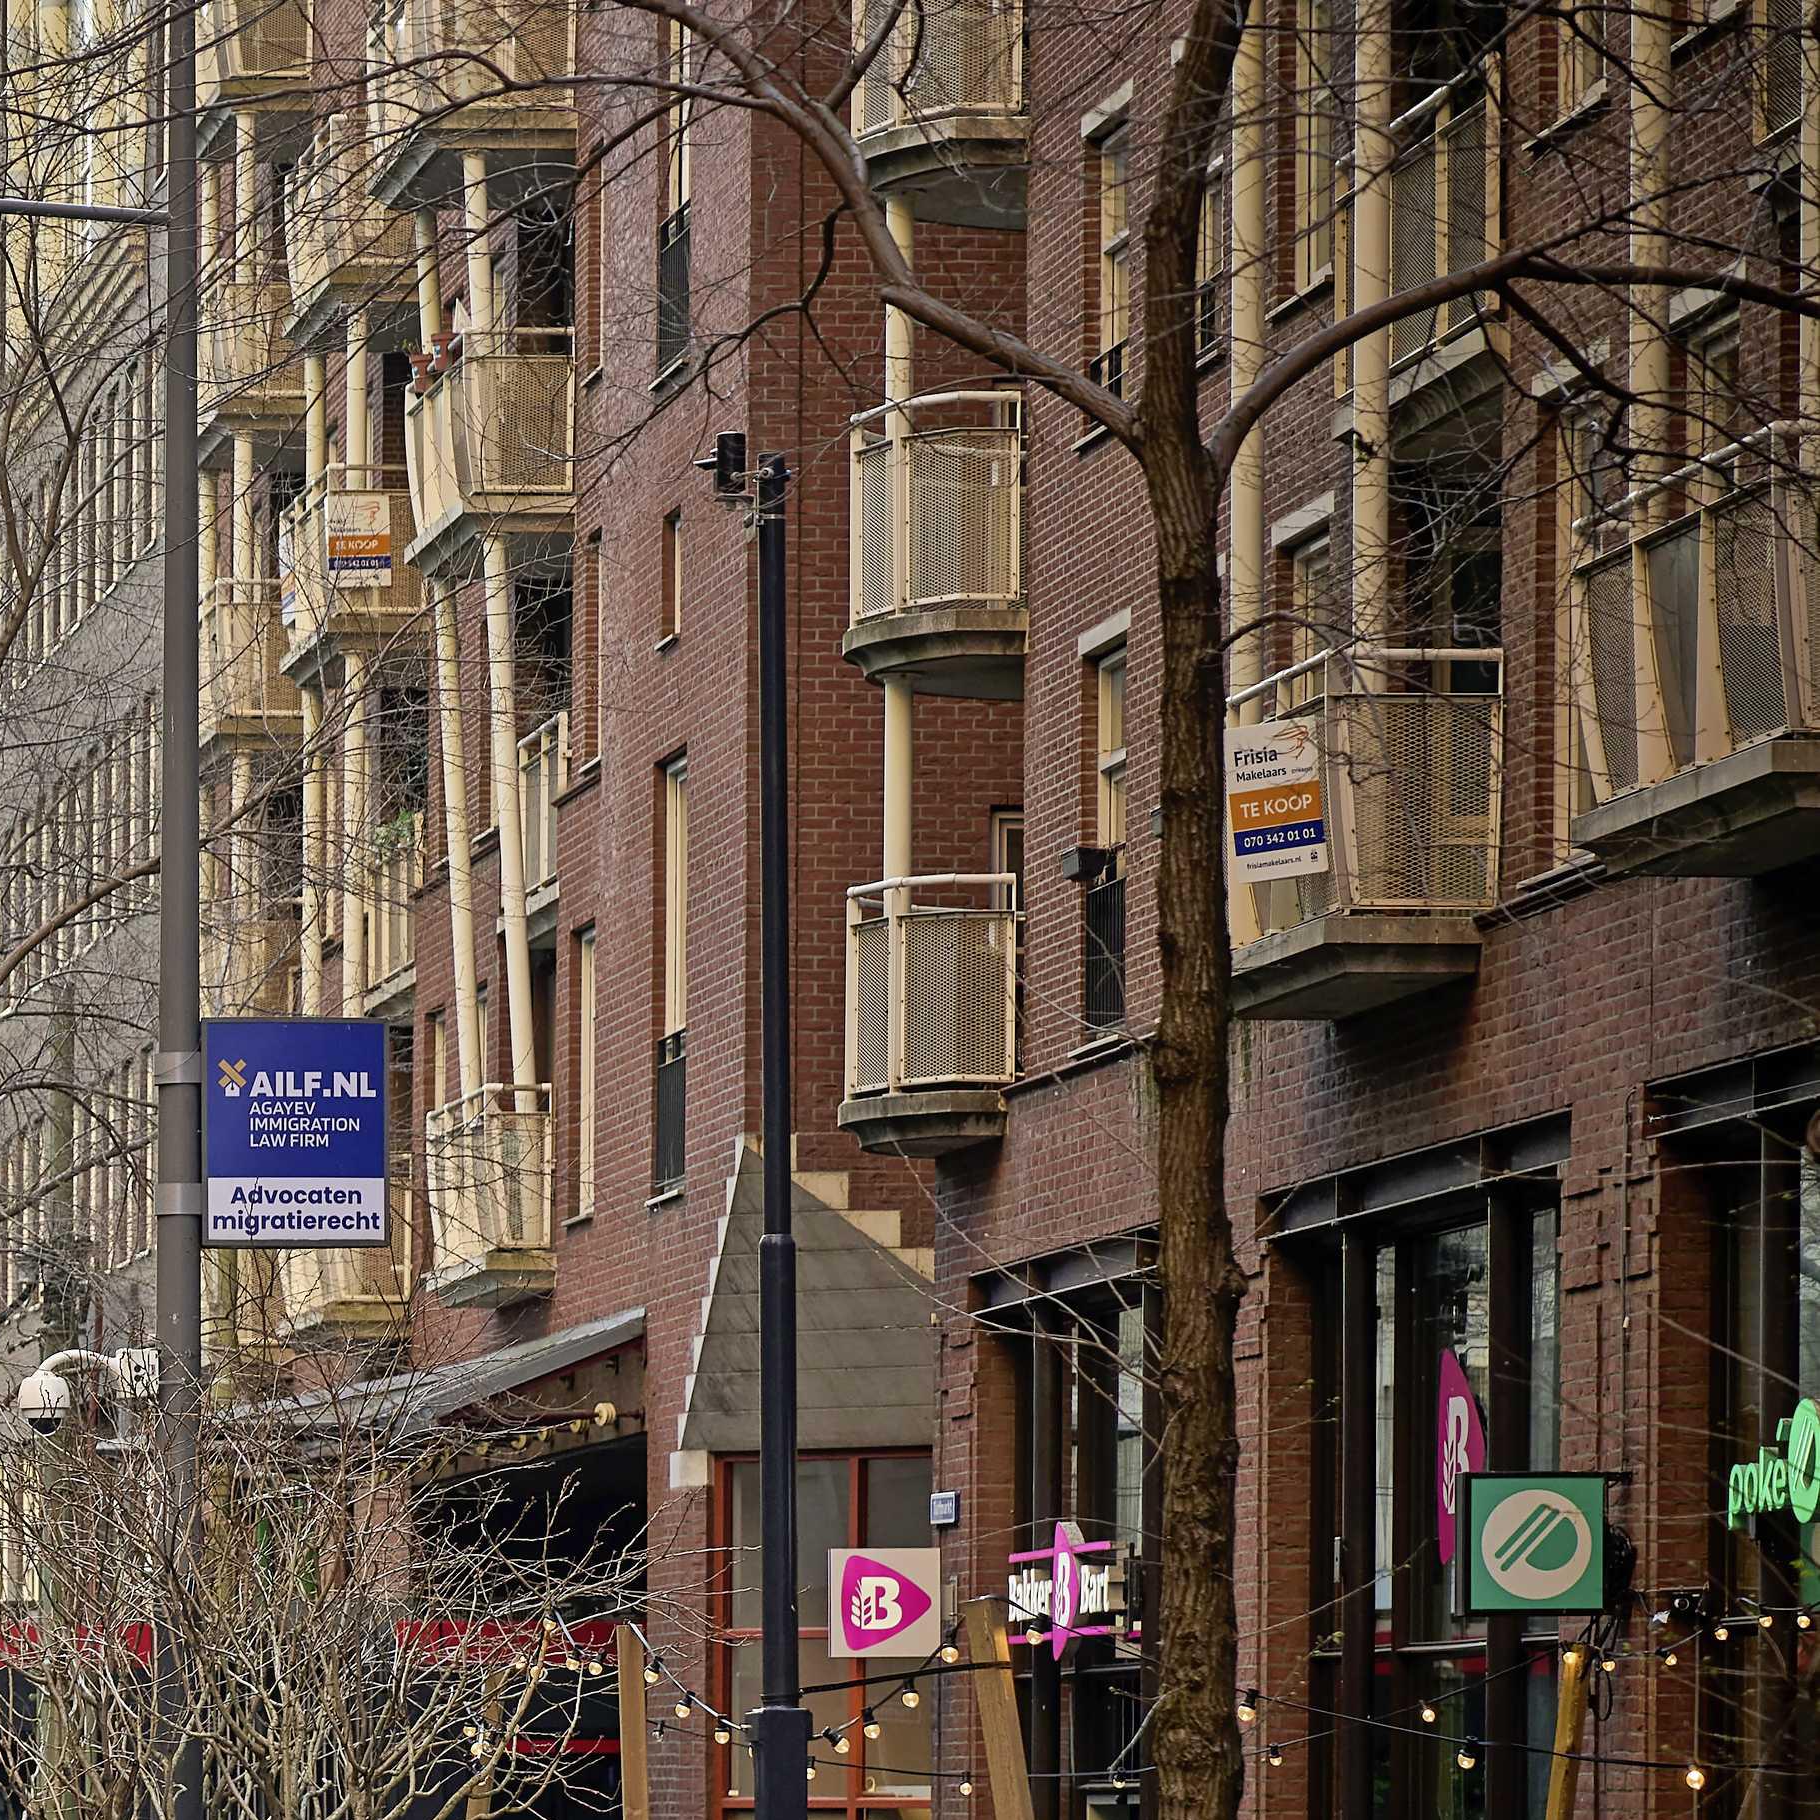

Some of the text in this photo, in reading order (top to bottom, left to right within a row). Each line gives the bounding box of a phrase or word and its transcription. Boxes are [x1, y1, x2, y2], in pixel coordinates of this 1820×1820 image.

[1234, 747, 1277, 767] Frisia
[1237, 767, 1287, 783] Makelaars
[1240, 794, 1312, 819] TE KOOP
[1244, 828, 1316, 848] 070 342 01 01
[1247, 856, 1302, 870] frisiamakelaars.nl
[250, 1071, 377, 1097] AILF.NL
[250, 1101, 316, 1115] AGAYEV
[250, 1118, 360, 1132] IMMIGRATION
[250, 1134, 330, 1148] LAW FIRM
[230, 1184, 362, 1206] Advocaten
[213, 1208, 380, 1236] migratierecht
[1008, 1568, 1053, 1622] Bakker
[1080, 1565, 1110, 1614] Bart
